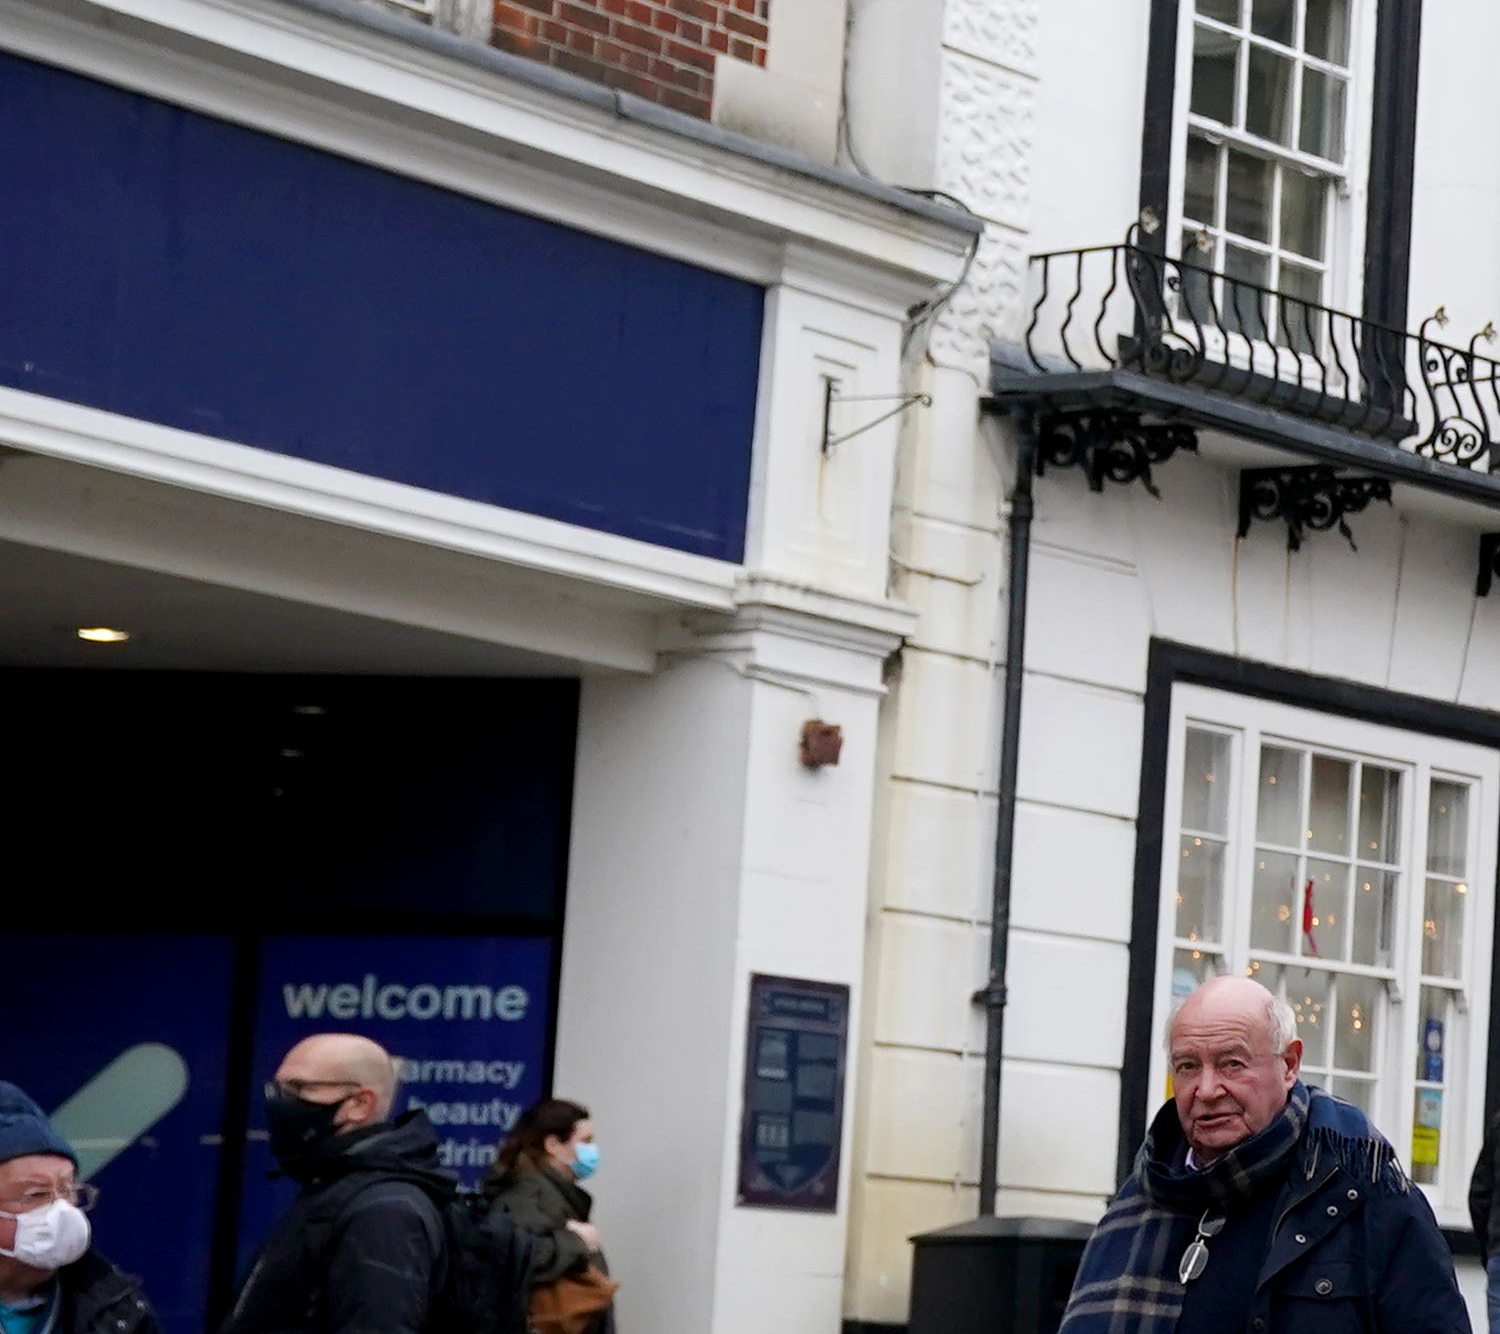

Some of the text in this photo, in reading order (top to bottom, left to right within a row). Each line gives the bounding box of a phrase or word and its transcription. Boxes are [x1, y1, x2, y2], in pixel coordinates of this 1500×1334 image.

[282, 973, 530, 1020] welcome
[402, 1058, 527, 1089] armacy
[436, 1137, 499, 1167] drin
